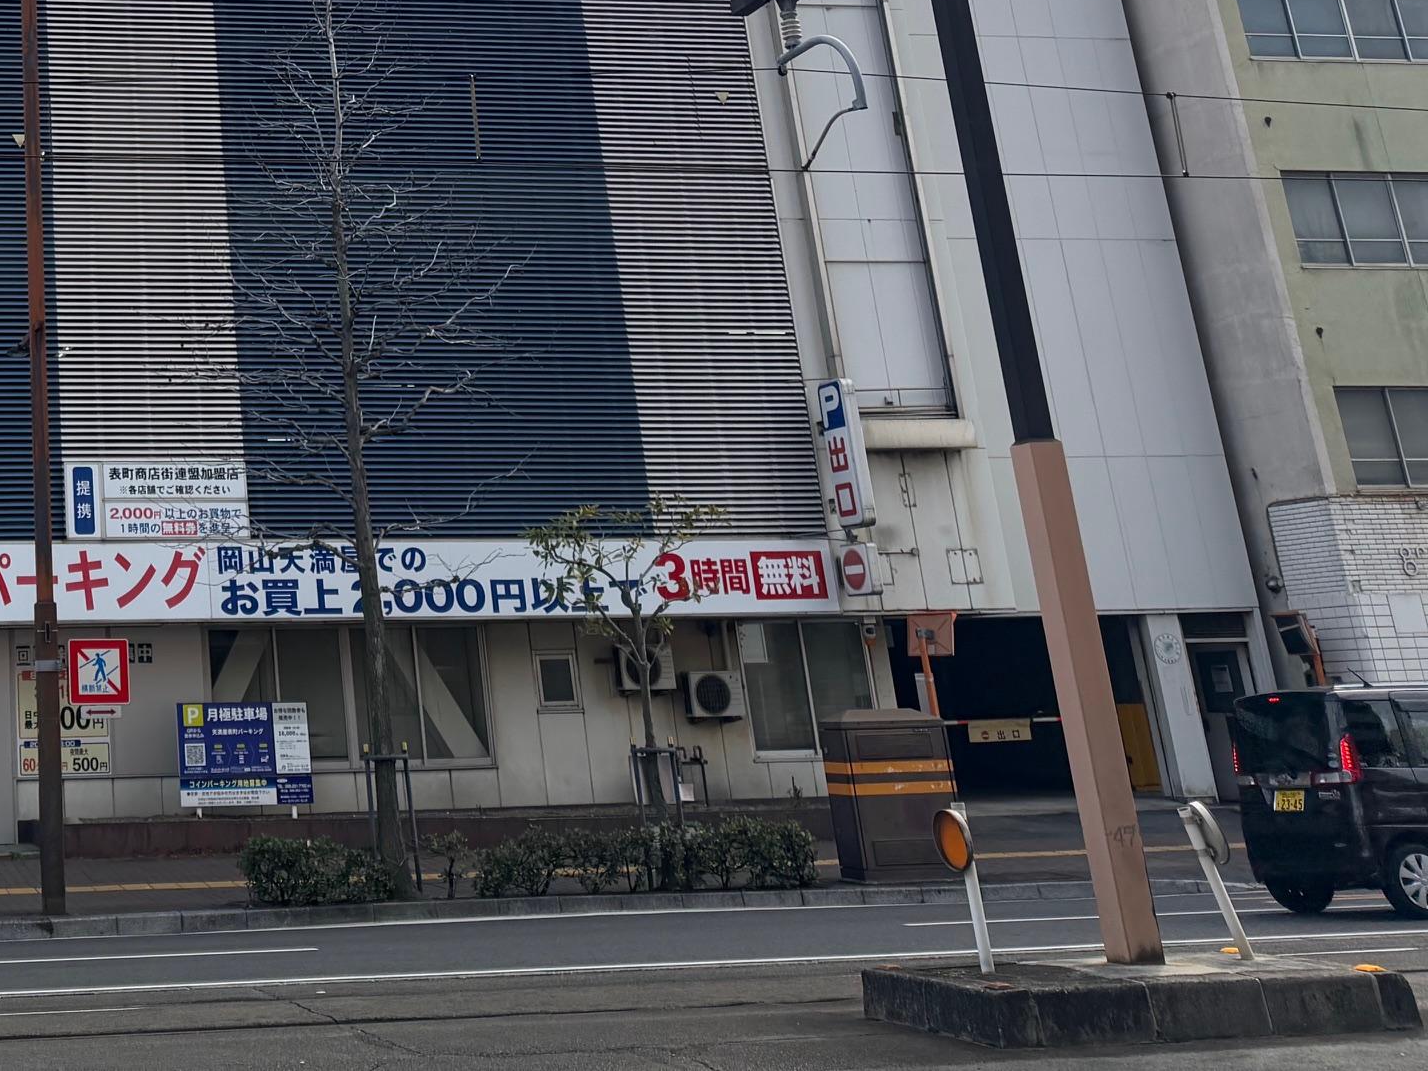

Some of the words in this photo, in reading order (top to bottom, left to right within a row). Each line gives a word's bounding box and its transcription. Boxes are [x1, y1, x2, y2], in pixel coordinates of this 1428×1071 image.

[821, 385, 840, 428] P
[109, 467, 238, 481] 表町商店街連盟加盟店
[828, 436, 857, 517] 出口
[76, 481, 92, 519] 提携
[217, 545, 426, 575] 岡山天満屋での
[187, 707, 200, 724] P
[207, 708, 268, 722] 月極駐車場
[23, 758, 36, 772] 60
[73, 757, 108, 772] 500円
